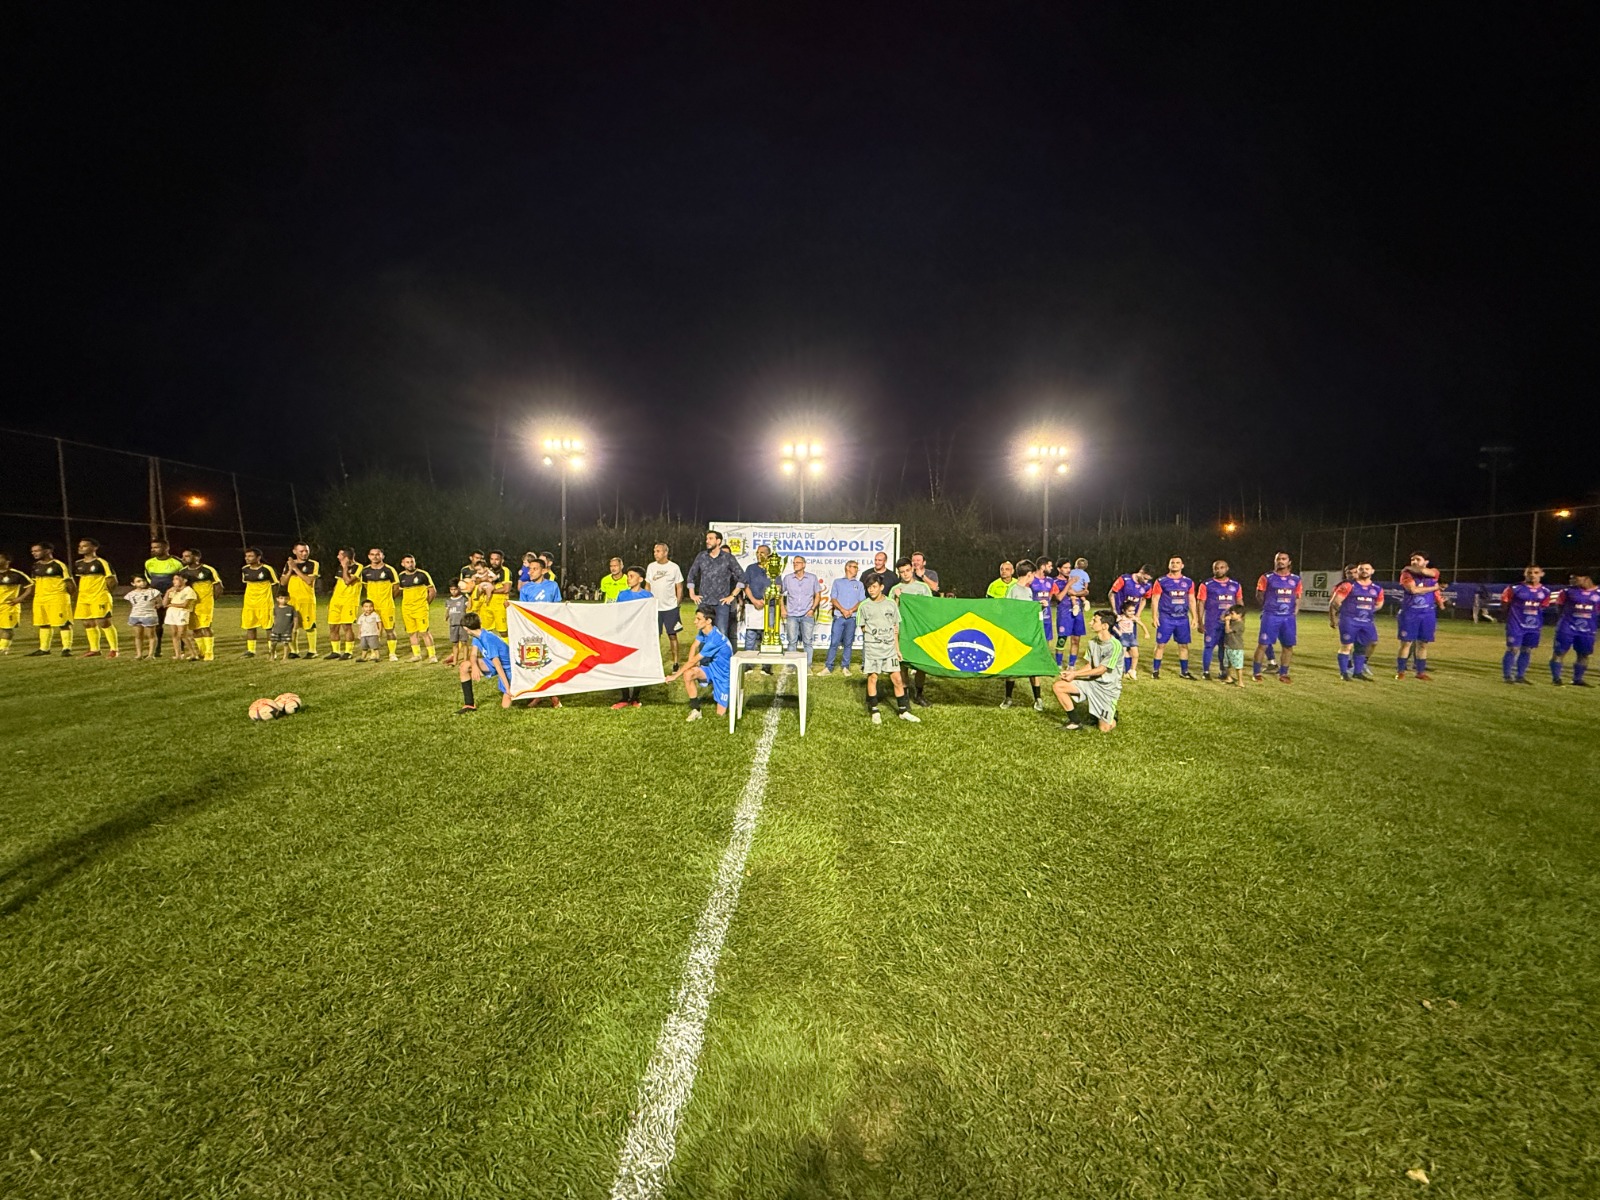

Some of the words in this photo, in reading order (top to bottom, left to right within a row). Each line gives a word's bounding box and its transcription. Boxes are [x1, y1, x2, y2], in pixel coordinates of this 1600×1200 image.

[752, 531, 803, 539] PREFEITURA
[752, 538, 884, 551] FERNANDÓPOLIS
[720, 693, 728, 701] 10
[1100, 709, 1108, 719] 11
